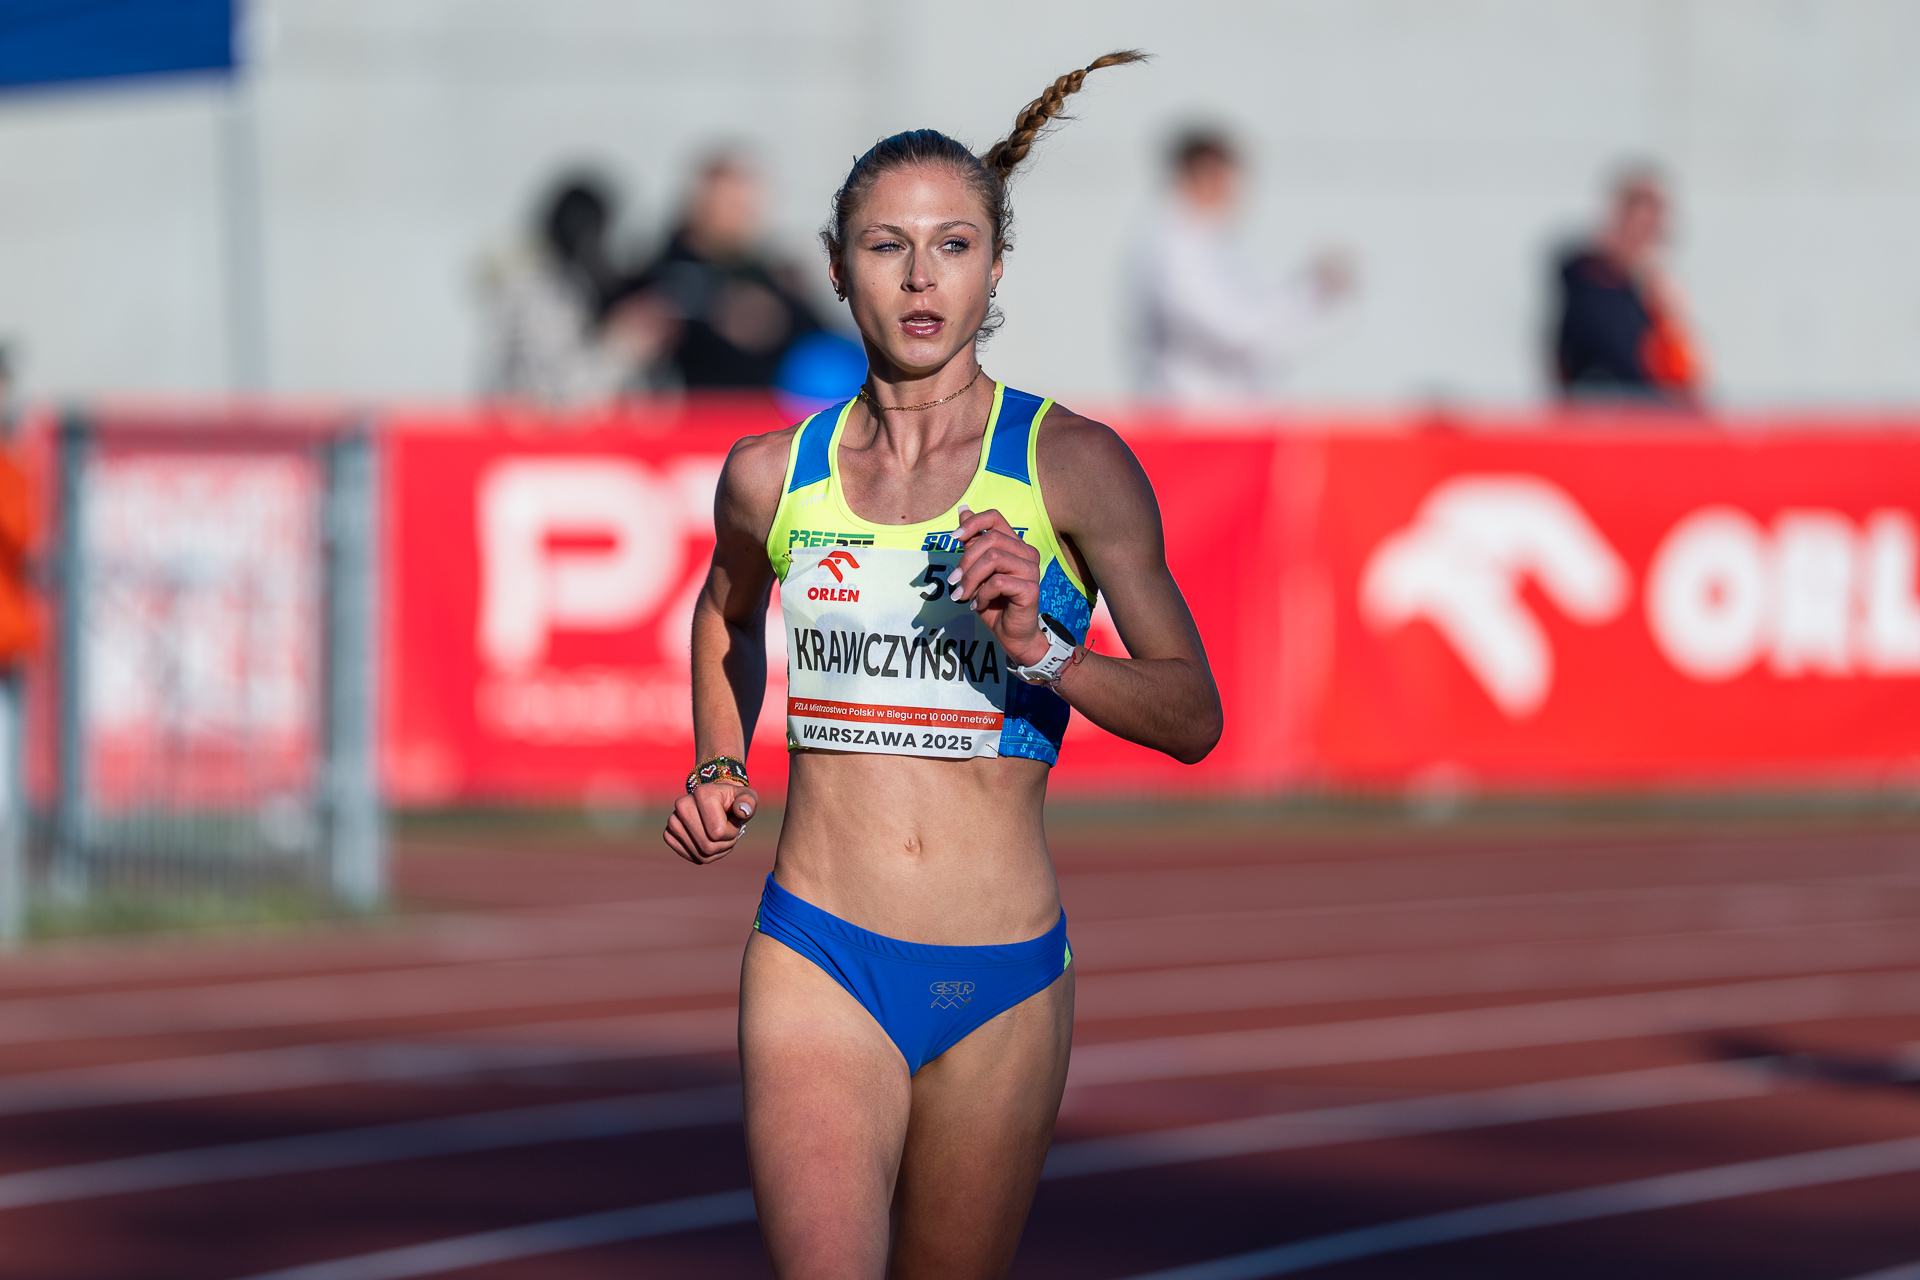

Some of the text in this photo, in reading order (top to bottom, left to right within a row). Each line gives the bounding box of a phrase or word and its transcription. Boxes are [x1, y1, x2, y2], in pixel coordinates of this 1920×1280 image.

[807, 586, 860, 603] ORLEN
[793, 627, 1000, 684] KRAWCZYŃSKA
[794, 702, 808, 711] PZLA
[809, 703, 847, 715] Mistrzostwa
[849, 707, 875, 717] Polski
[876, 710, 885, 718] w
[886, 710, 913, 721] Biegu
[929, 712, 938, 721] 10
[940, 713, 958, 722] 000
[960, 715, 997, 725] metrów
[803, 724, 972, 751] WARSZAWA 2025
